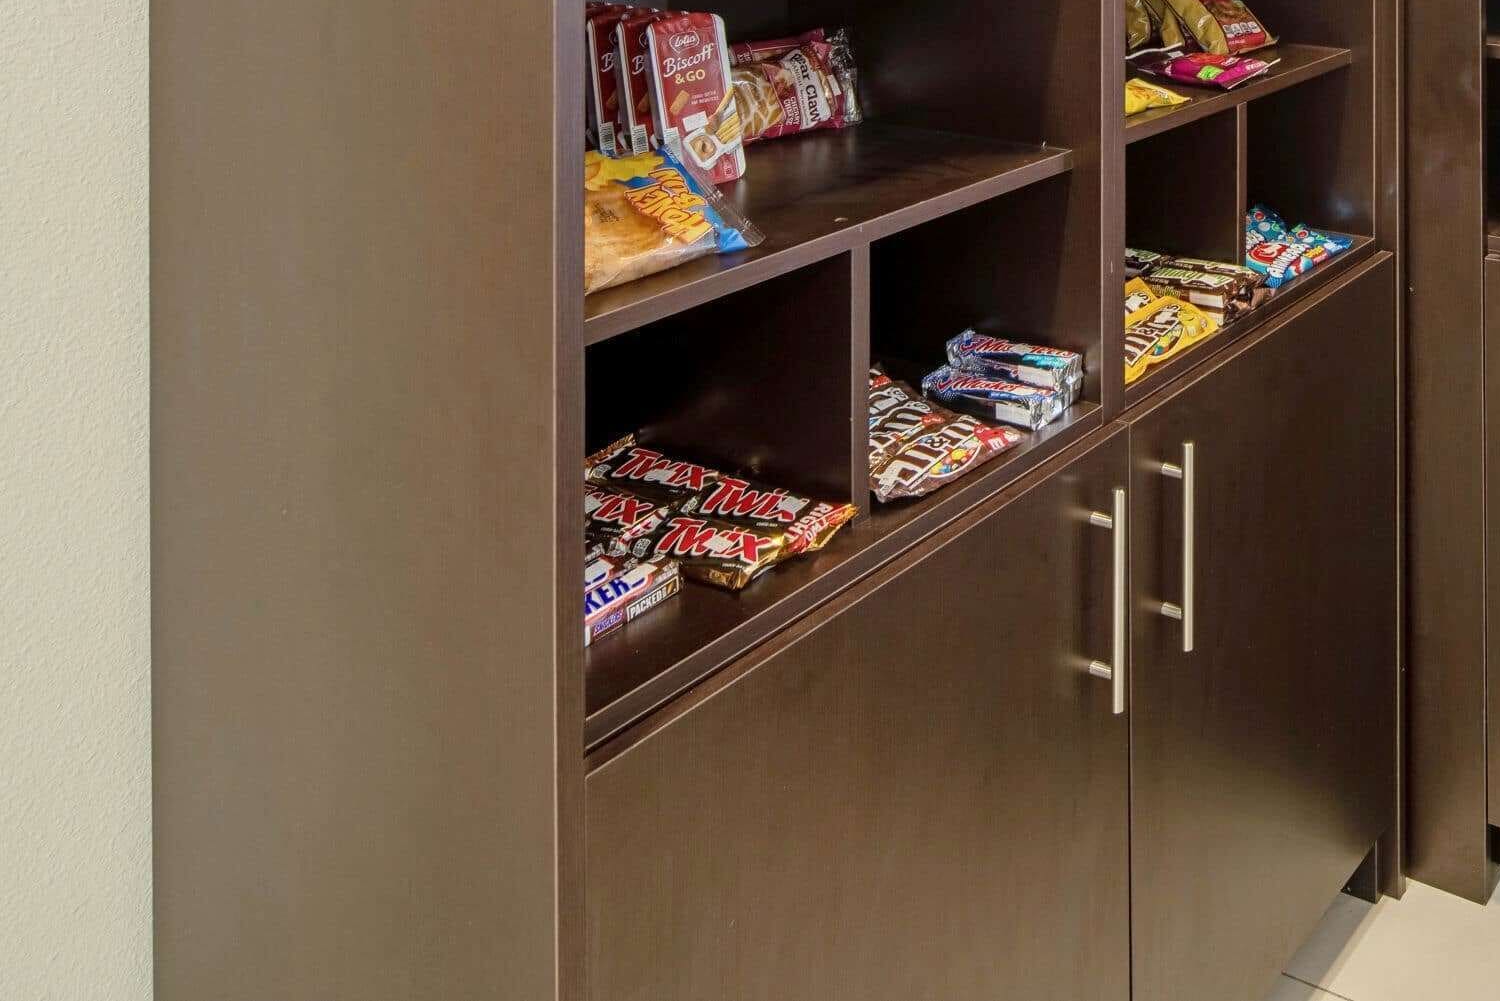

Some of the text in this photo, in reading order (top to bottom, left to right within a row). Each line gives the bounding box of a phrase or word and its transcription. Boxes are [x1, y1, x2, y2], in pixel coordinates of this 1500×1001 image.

[663, 43, 715, 77] Biscoff
[675, 69, 706, 84] & GO
[805, 84, 821, 122] Claw
